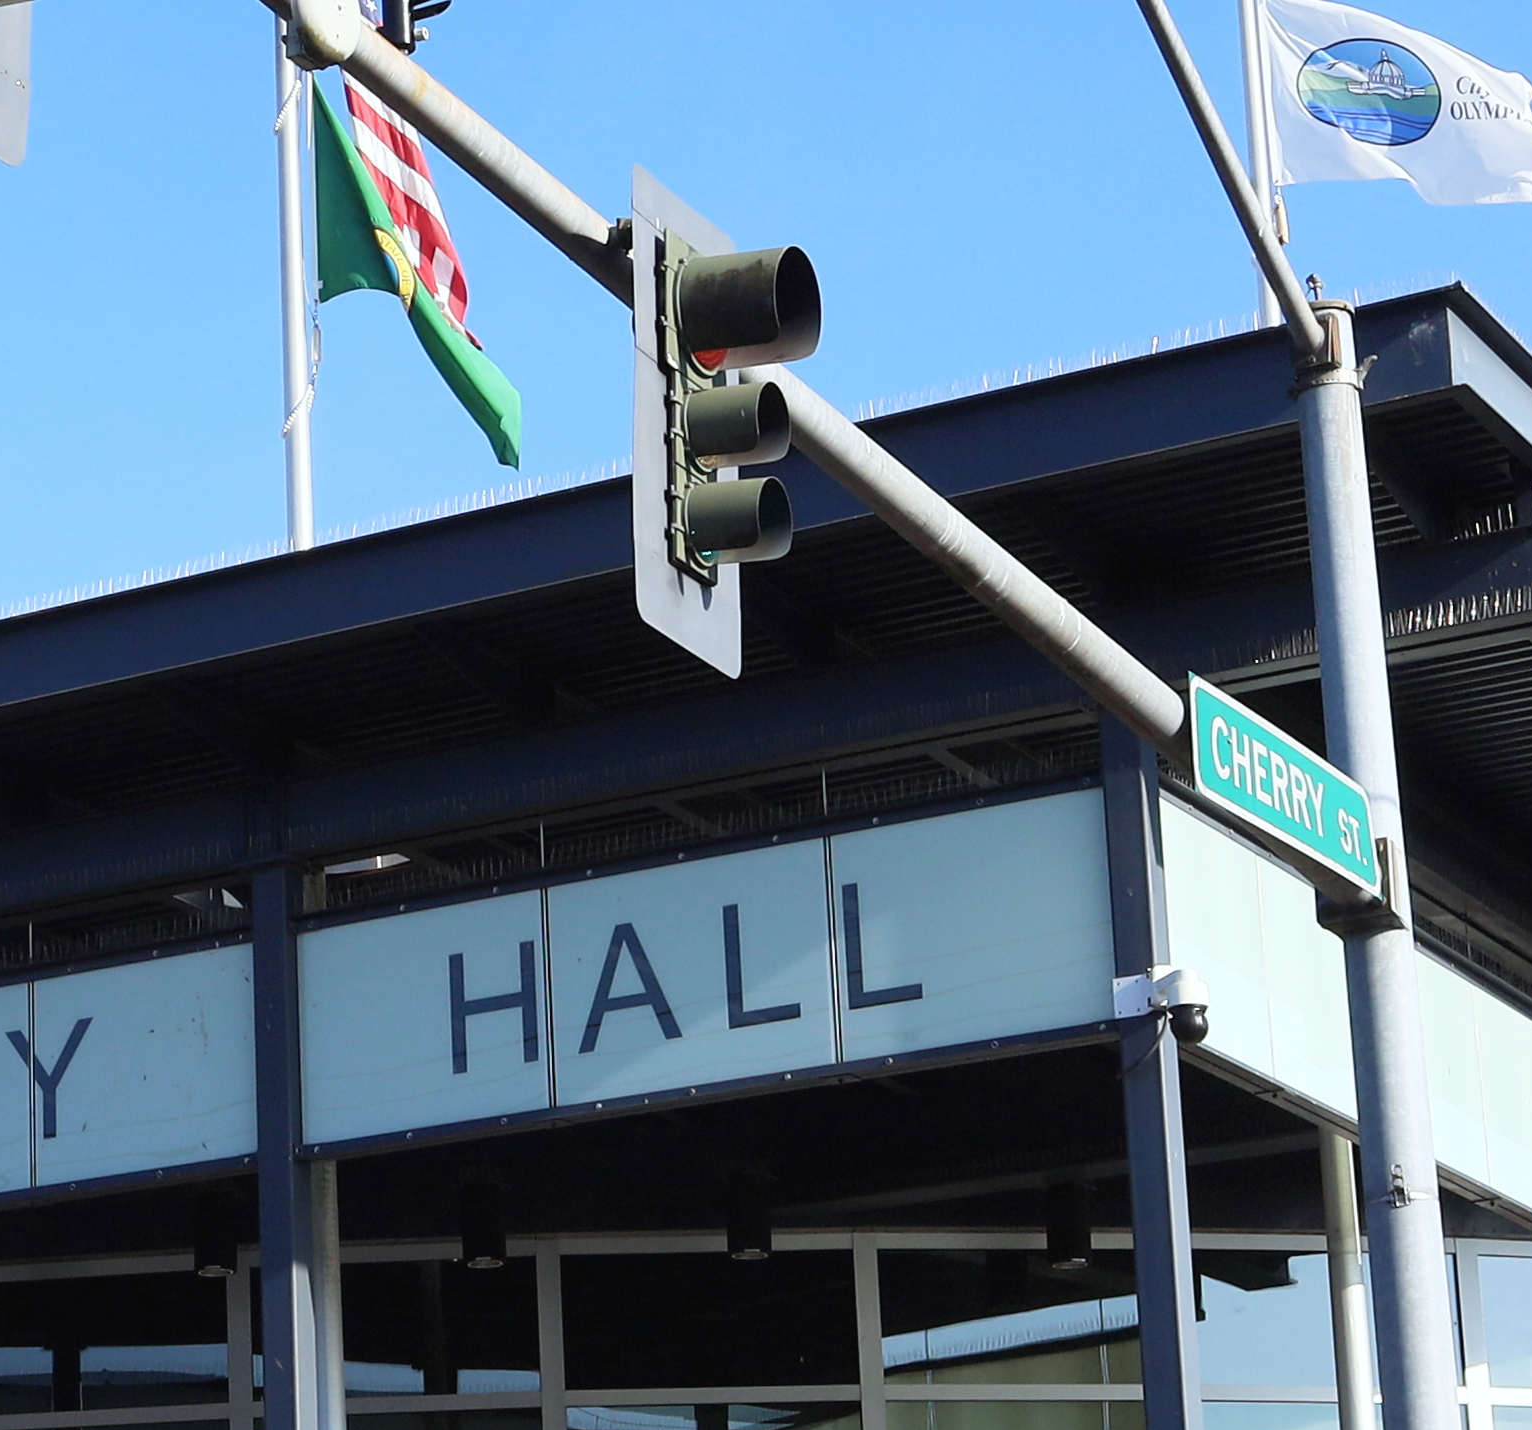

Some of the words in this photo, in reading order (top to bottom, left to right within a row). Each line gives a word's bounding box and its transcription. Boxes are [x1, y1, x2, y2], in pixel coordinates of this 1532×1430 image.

[1210, 716, 1326, 838] CHERRY
[1337, 808, 1369, 866] ST.
[448, 883, 923, 1075] HALL
